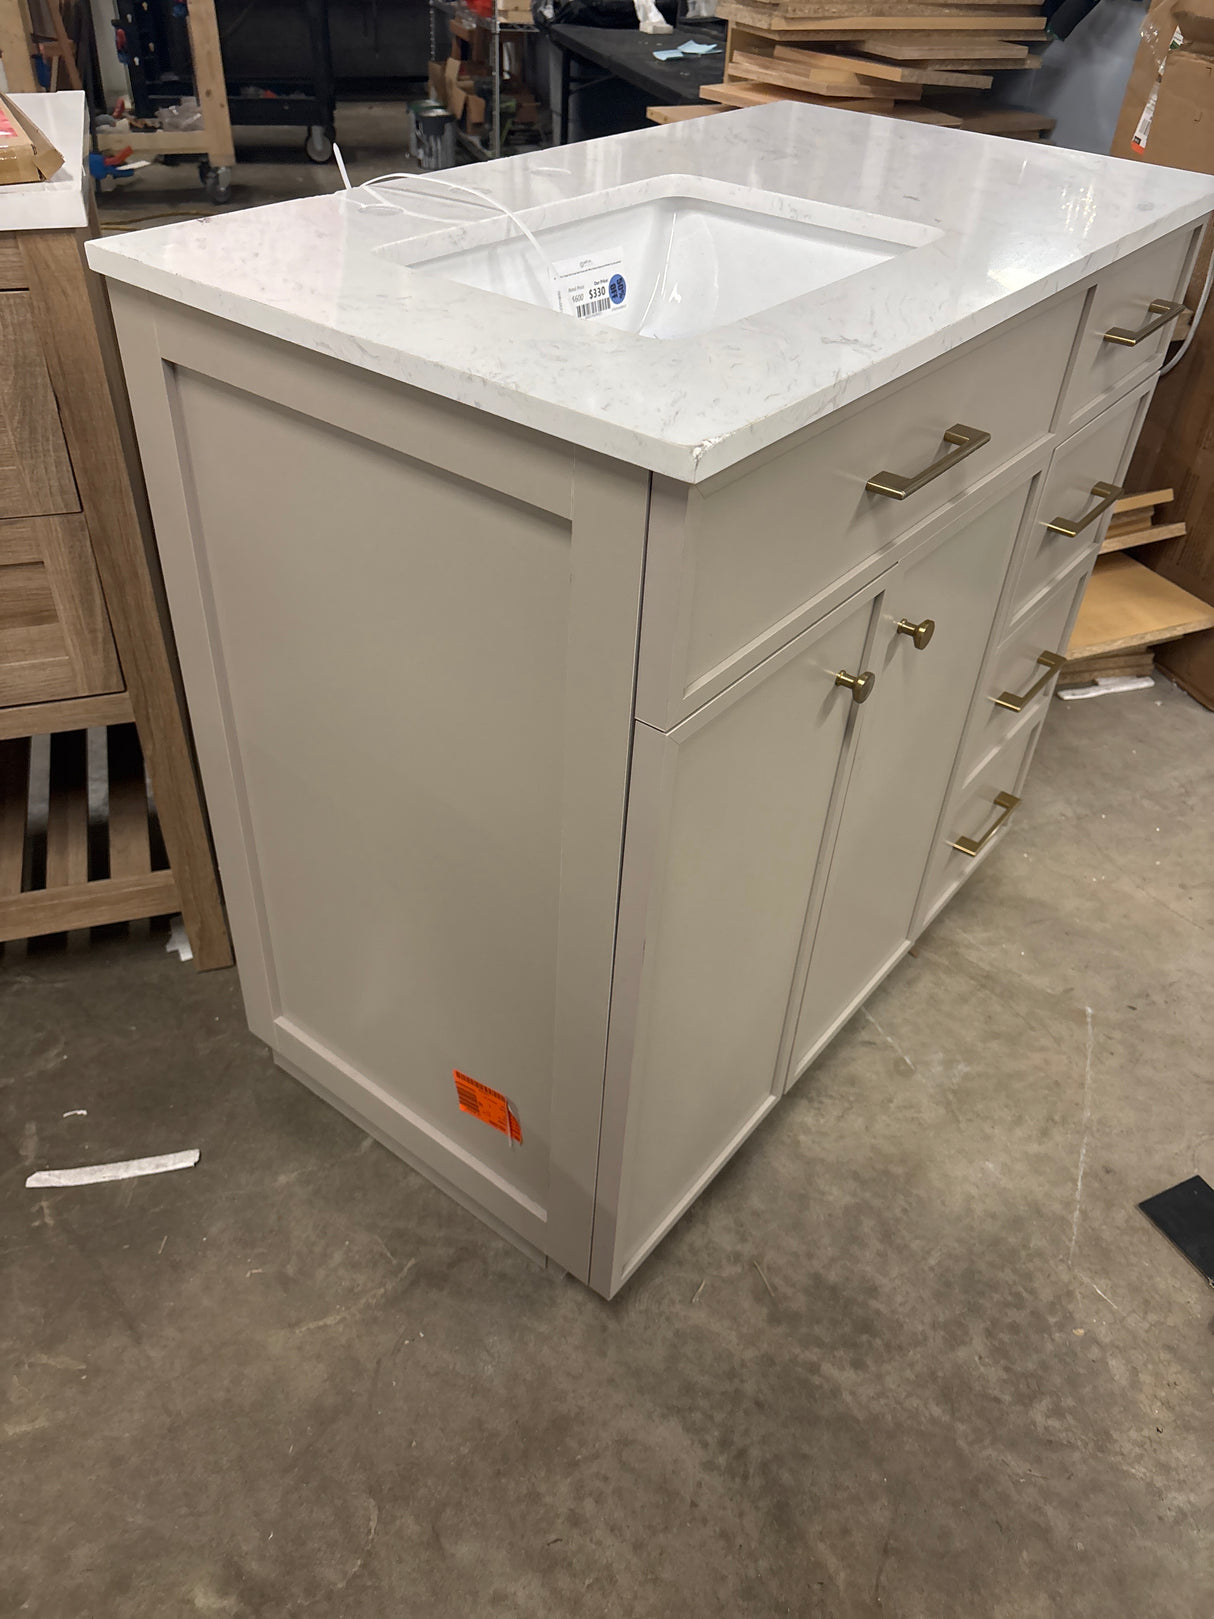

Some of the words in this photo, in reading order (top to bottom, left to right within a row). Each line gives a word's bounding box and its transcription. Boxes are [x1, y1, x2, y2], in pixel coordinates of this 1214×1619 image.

[588, 286, 606, 299] $330
[610, 283, 618, 298] OFF
[616, 278, 625, 298] 50%
